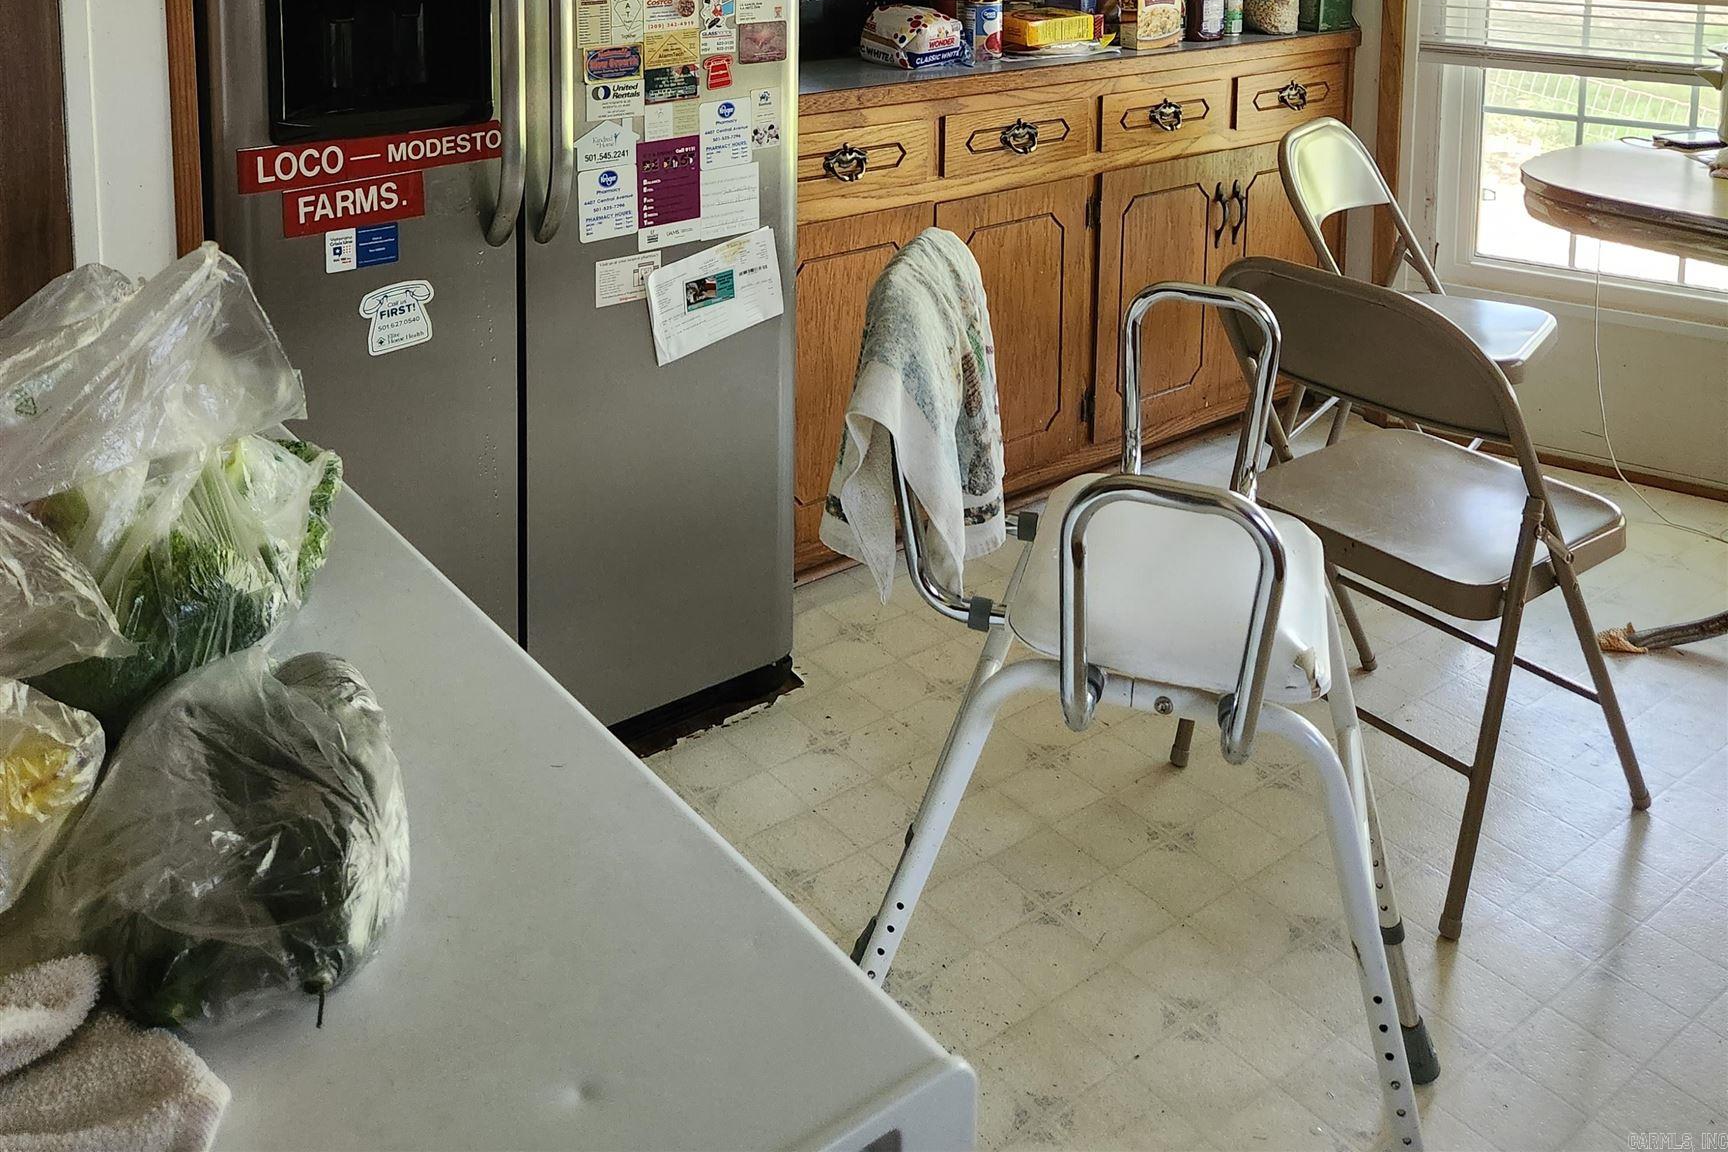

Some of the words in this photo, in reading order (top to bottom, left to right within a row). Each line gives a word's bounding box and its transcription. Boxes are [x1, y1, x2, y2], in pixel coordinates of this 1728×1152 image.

[929, 37, 956, 49] WONDER
[916, 54, 941, 65] CLASSIC
[941, 50, 960, 60] WHITE
[612, 83, 639, 92] United
[612, 91, 641, 100] Rentals
[706, 143, 731, 151] PHARMACY
[257, 146, 344, 184] LOCO
[388, 129, 502, 163] MODESTO
[585, 150, 629, 162] 501.545.2241
[600, 175, 618, 186] Kroger
[298, 182, 408, 224] FARMS.
[586, 213, 614, 222] PHARMACY
[387, 300, 399, 308] Call
[380, 303, 416, 320] FIRST!
